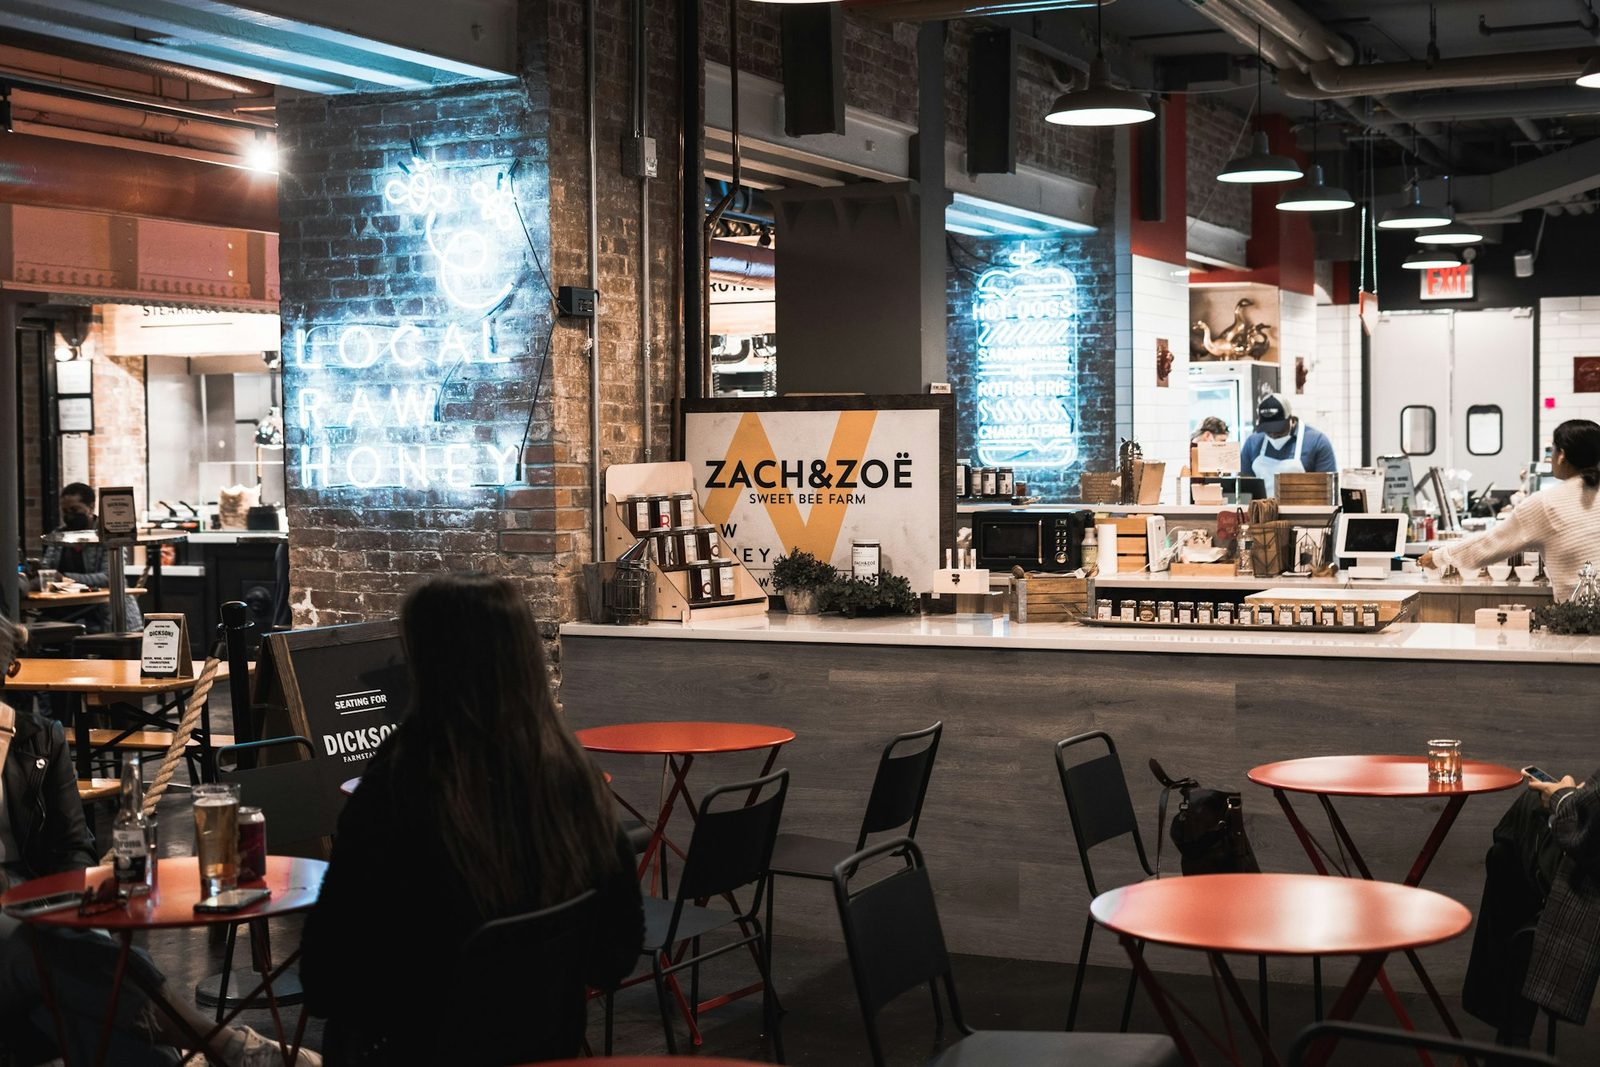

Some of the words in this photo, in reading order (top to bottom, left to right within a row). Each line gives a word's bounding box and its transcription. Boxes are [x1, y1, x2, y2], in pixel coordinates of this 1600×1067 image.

[1426, 264, 1470, 295] EXIT
[973, 301, 1008, 320] HOT
[1017, 301, 1073, 318] DOGS
[296, 320, 510, 369] LOCAL
[978, 381, 1071, 397] ROTISSERIE
[299, 387, 434, 429] RAW
[301, 443, 518, 488] HONEY
[705, 452, 913, 489] ZACH&ZOË
[749, 493, 794, 504] SWEET
[799, 493, 823, 504] BEE
[829, 493, 866, 504] FARM
[660, 515, 670, 528] R
[334, 697, 369, 710] SEATING
[369, 694, 387, 704] FOR
[323, 723, 399, 756] DICKSO
[343, 751, 378, 762] FARMSTA
